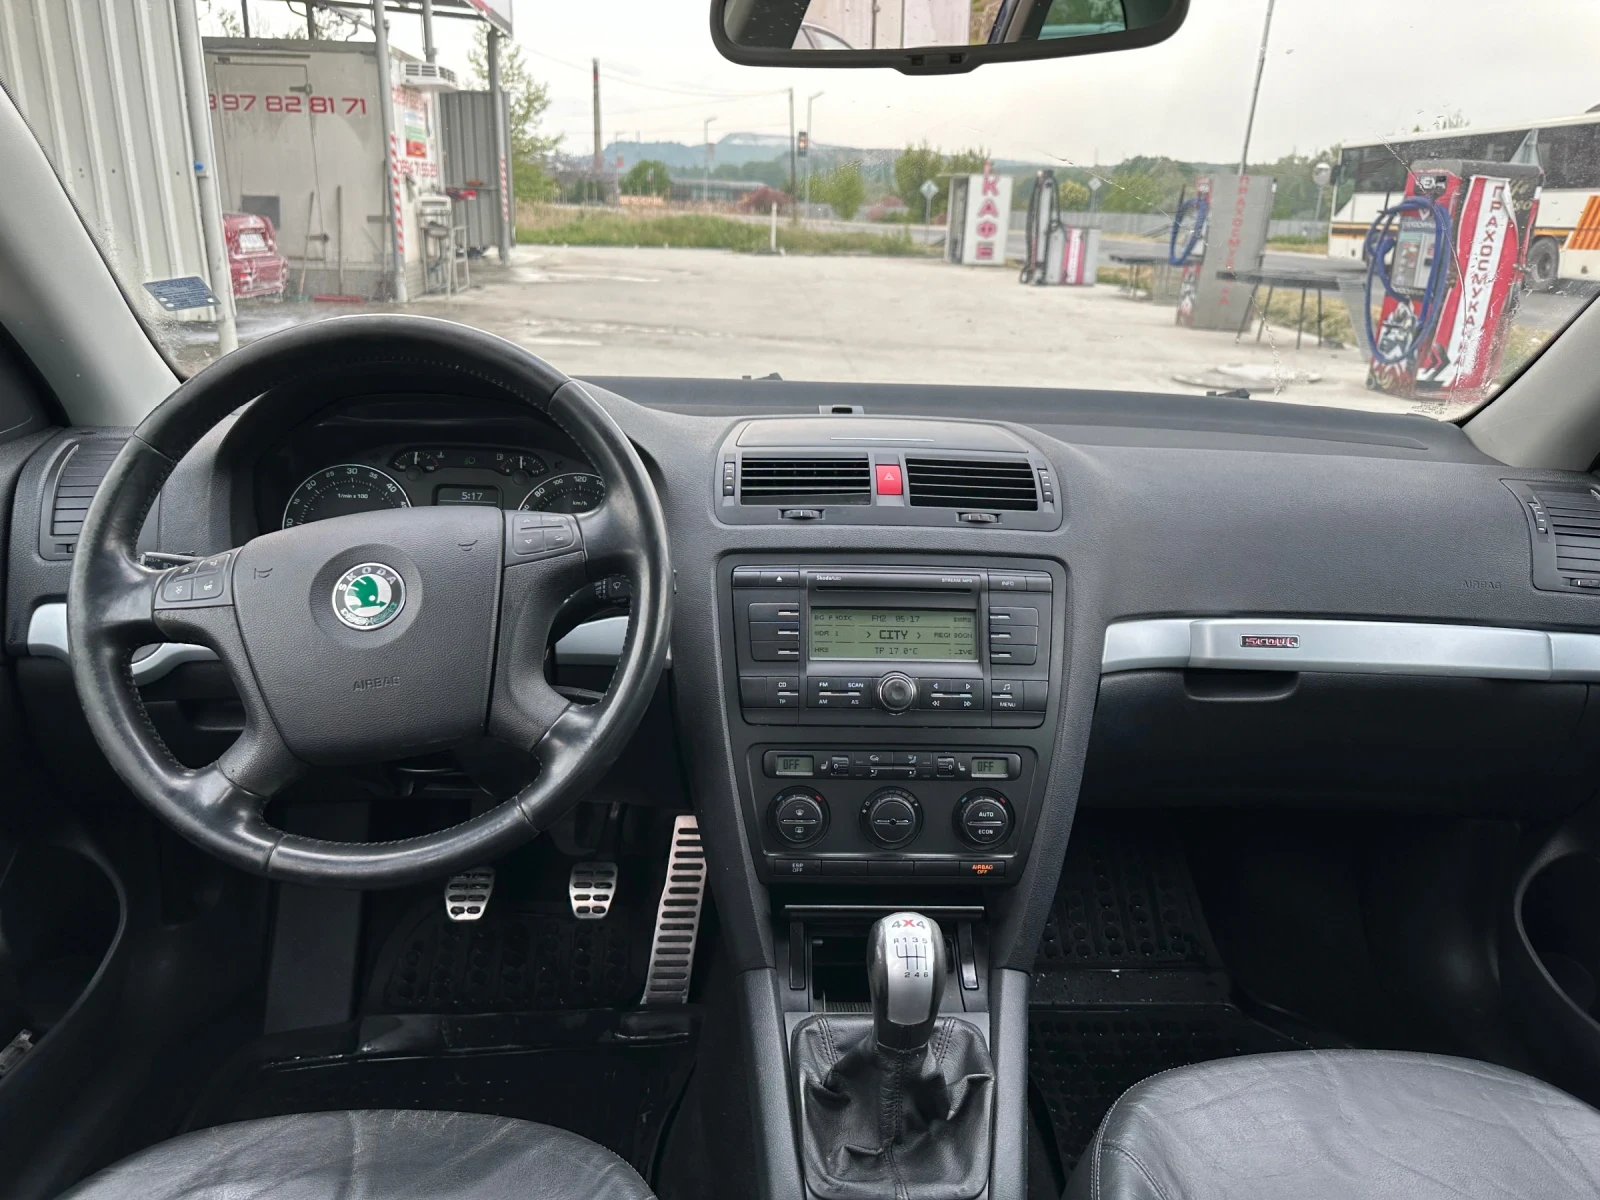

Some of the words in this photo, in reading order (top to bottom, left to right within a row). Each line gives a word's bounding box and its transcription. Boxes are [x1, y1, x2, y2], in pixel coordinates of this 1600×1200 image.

[265, 95, 302, 113] 82
[309, 96, 335, 114] 81
[341, 97, 367, 115] 71
[325, 470, 335, 478] 25
[346, 467, 358, 475] 30
[369, 471, 378, 480] 35
[573, 475, 588, 483] 120
[305, 479, 317, 491] 20
[386, 481, 398, 493] 40
[461, 491, 483, 501] 5:17
[534, 487, 546, 498] 80
[871, 614, 887, 622] FM2
[879, 629, 909, 640] CITY
[874, 646, 885, 655] TP
[783, 758, 800, 770] OFF
[977, 761, 995, 772] OFF
